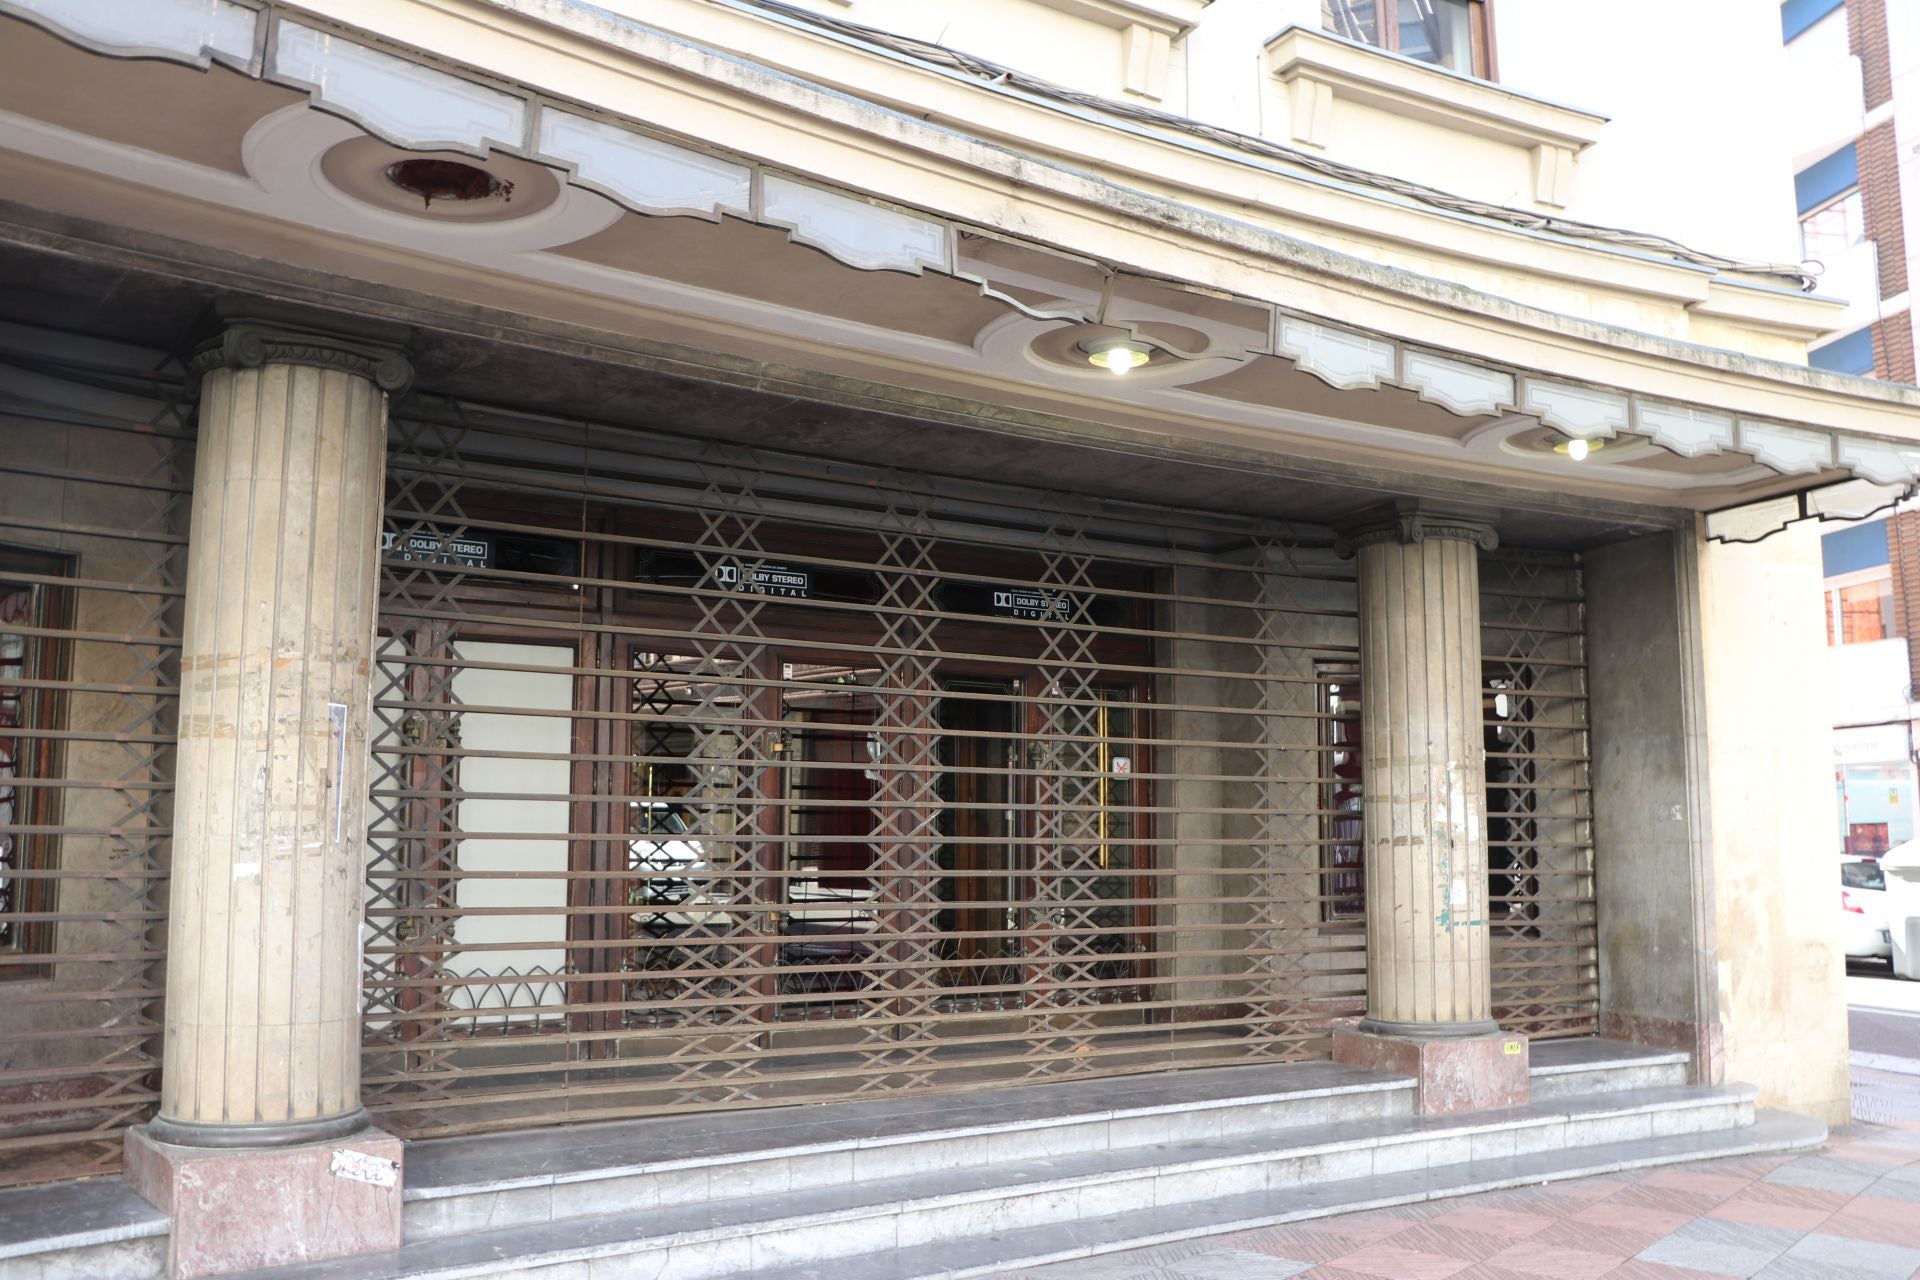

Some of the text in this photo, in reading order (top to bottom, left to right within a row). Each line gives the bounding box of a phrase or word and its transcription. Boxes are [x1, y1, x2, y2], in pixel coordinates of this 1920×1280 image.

[410, 539, 484, 554] DOLBY TEREO
[404, 554, 486, 568] DIAL
[743, 572, 804, 585] LBY STEREO
[1016, 597, 1067, 609] DOLBY STEO
[1013, 609, 1069, 620] DIGITL
